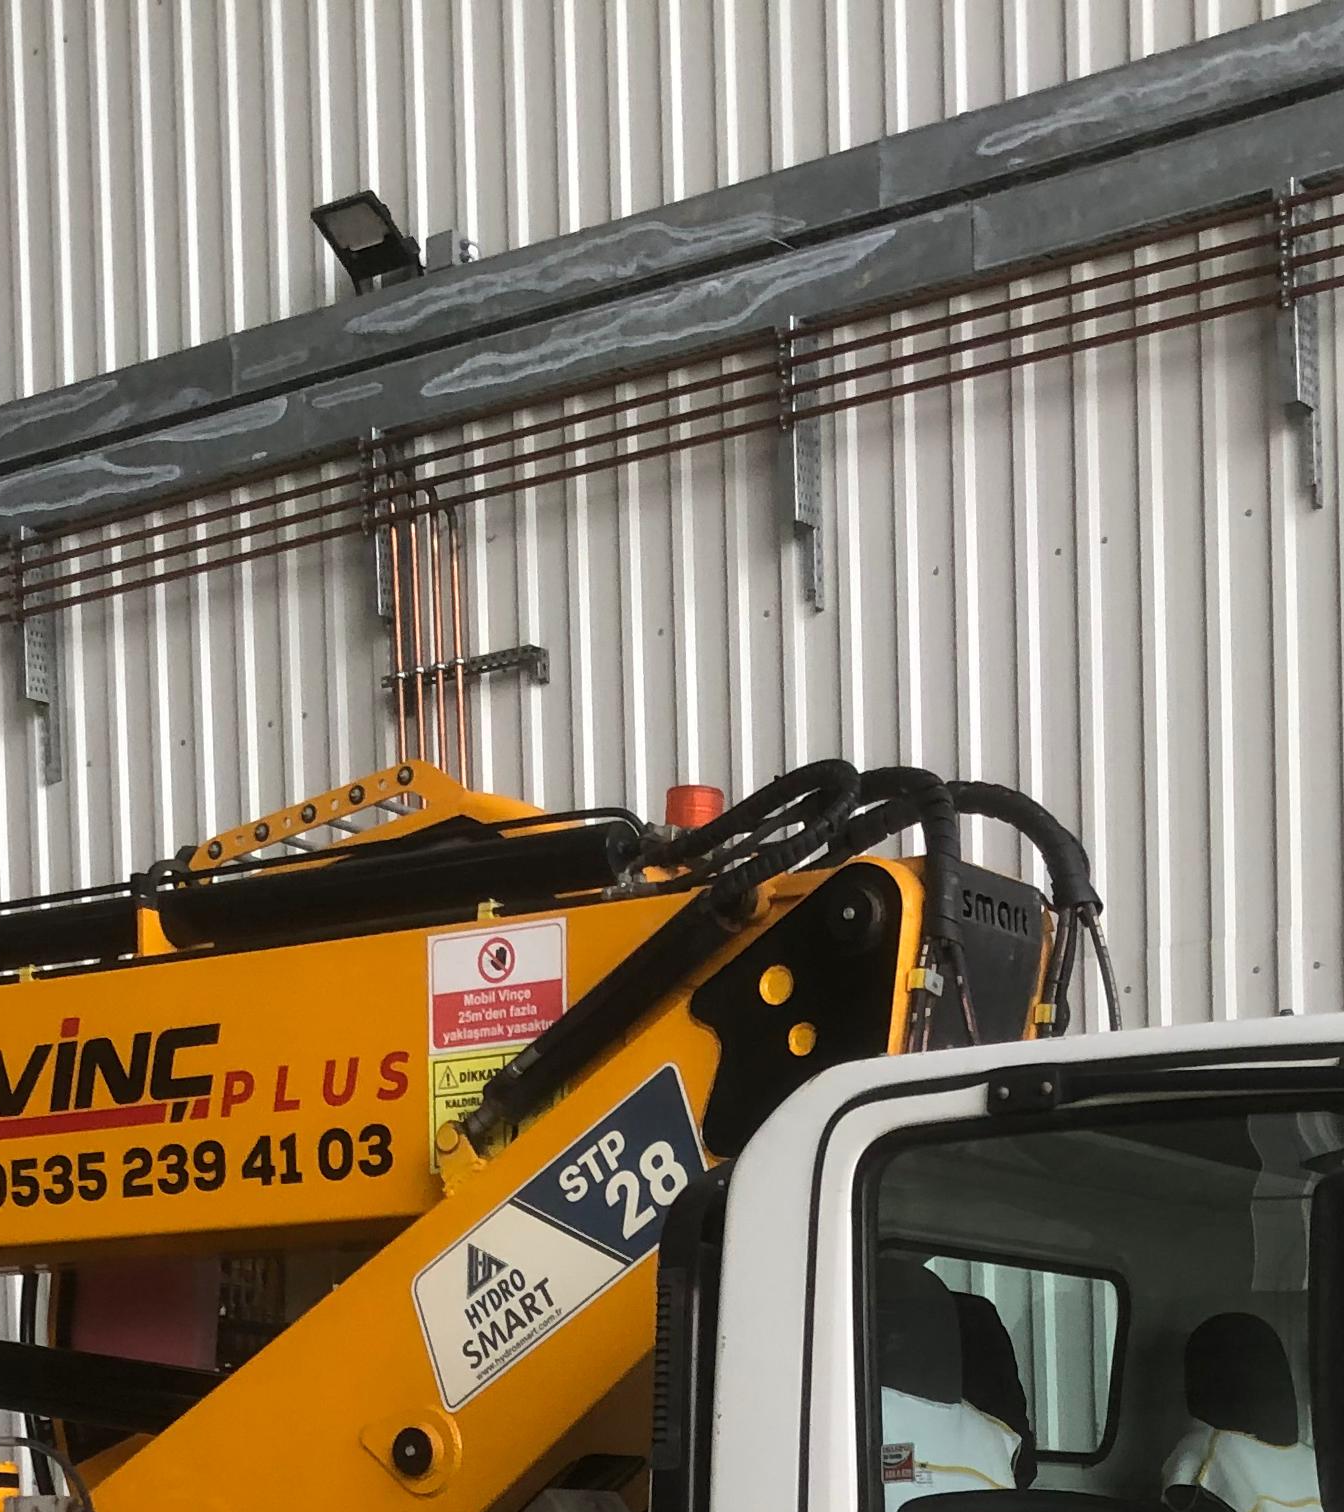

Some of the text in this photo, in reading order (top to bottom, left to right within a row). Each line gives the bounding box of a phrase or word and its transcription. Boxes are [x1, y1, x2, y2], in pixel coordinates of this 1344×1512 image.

[962, 889, 1029, 936] smart
[463, 988, 532, 1006] Mobil Vinçe
[509, 1003, 537, 1017] fazla
[442, 1023, 505, 1045] yaklaşmak
[219, 1050, 410, 1119] PLUS
[122, 1140, 227, 1199] 239
[242, 1133, 304, 1187] 41
[317, 1123, 395, 1182] 03
[558, 1130, 626, 1203] STP
[605, 1140, 689, 1241] 28
[462, 1277, 556, 1370] SMART
[464, 1268, 526, 1330] HYDRO
